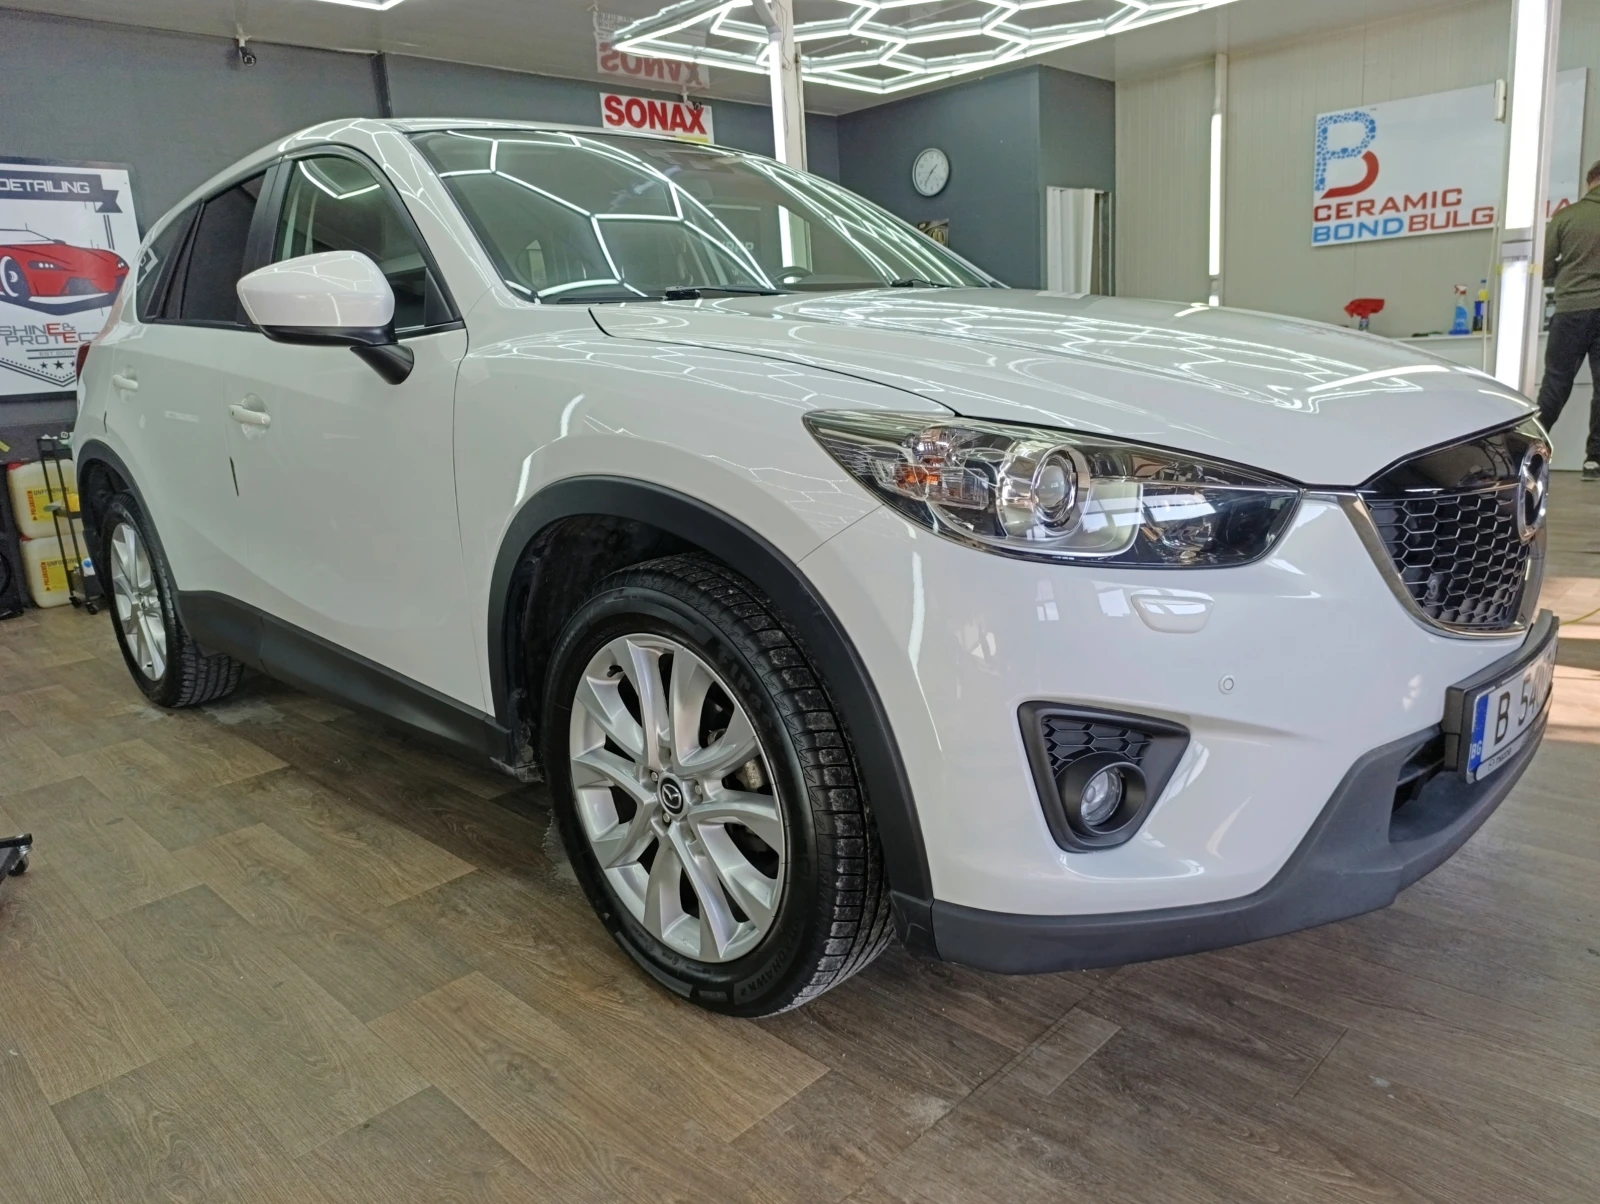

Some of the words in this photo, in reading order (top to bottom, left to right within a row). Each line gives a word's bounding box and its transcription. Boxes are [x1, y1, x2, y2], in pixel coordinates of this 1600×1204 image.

[604, 95, 707, 135] SONAX
[1313, 187, 1462, 222] CERAMIC
[0, 323, 62, 336] SHINE
[1494, 691, 1511, 746] B
